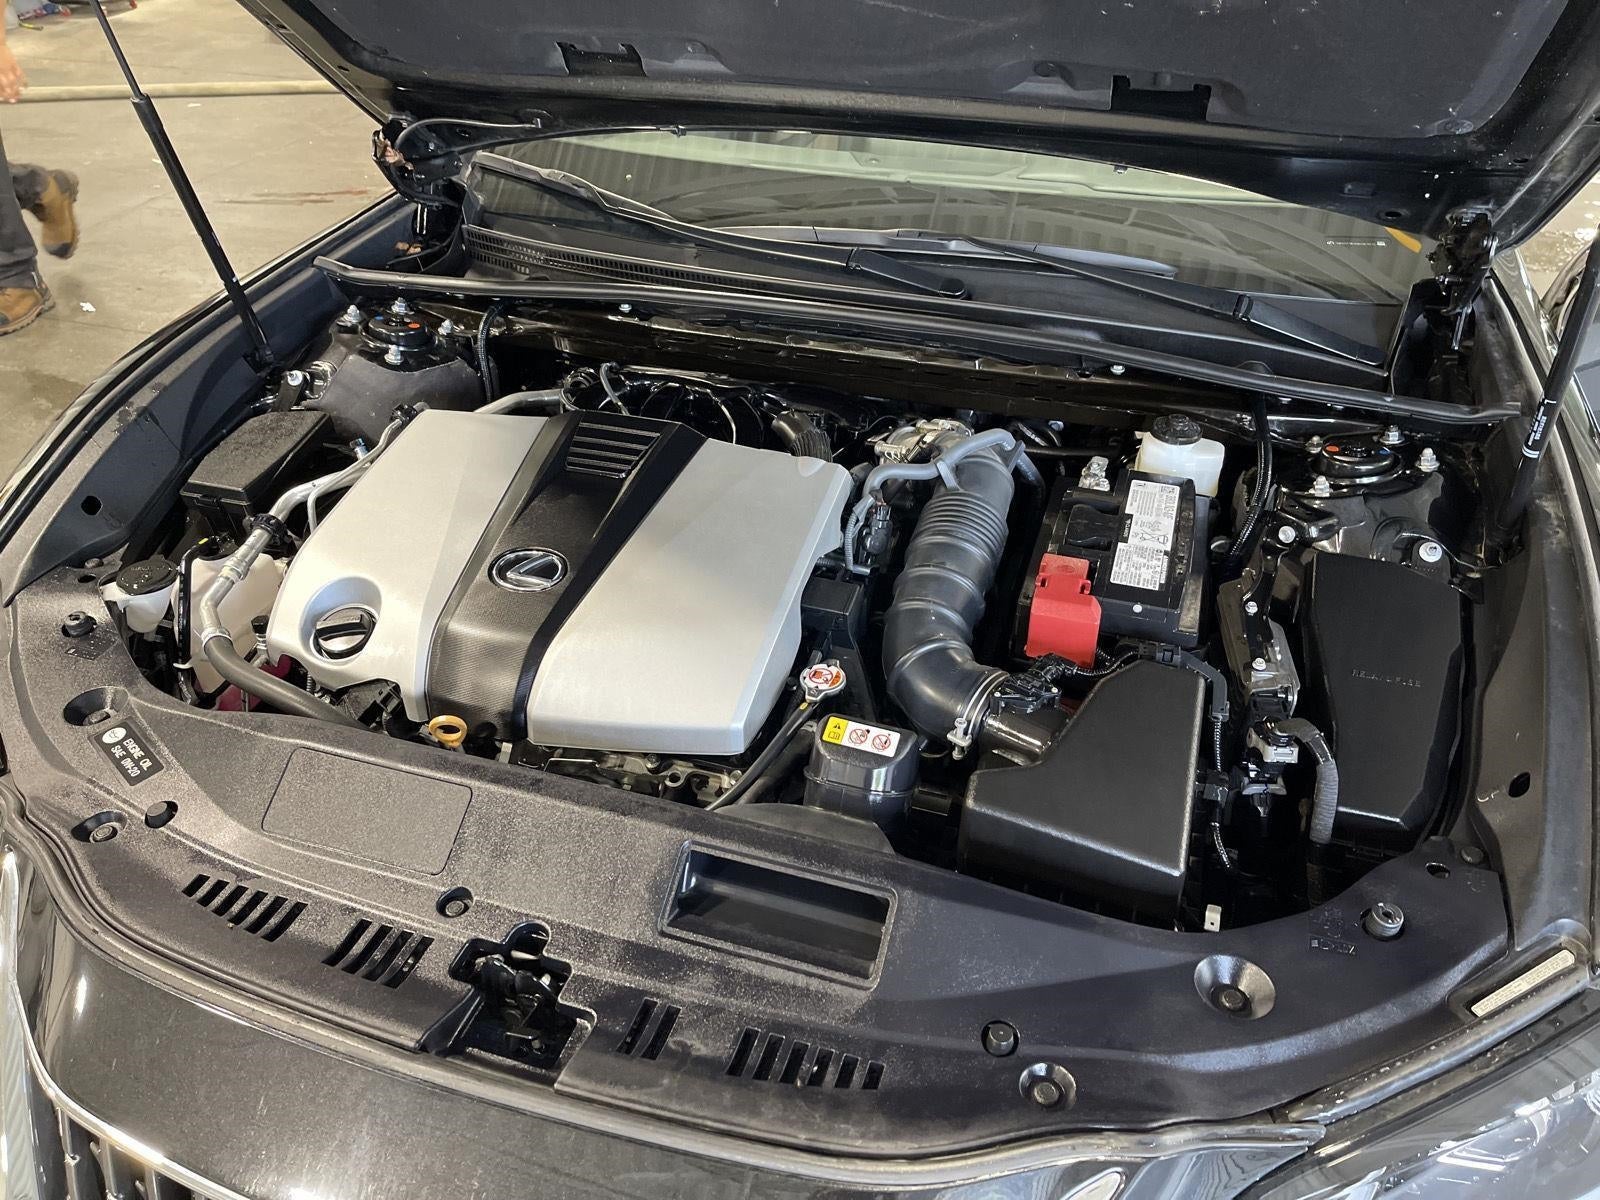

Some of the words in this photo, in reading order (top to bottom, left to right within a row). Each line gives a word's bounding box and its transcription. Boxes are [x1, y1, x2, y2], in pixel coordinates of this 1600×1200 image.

[111, 745, 126, 759] SAE
[123, 738, 145, 759] ENGINE
[140, 758, 152, 771] OIL
